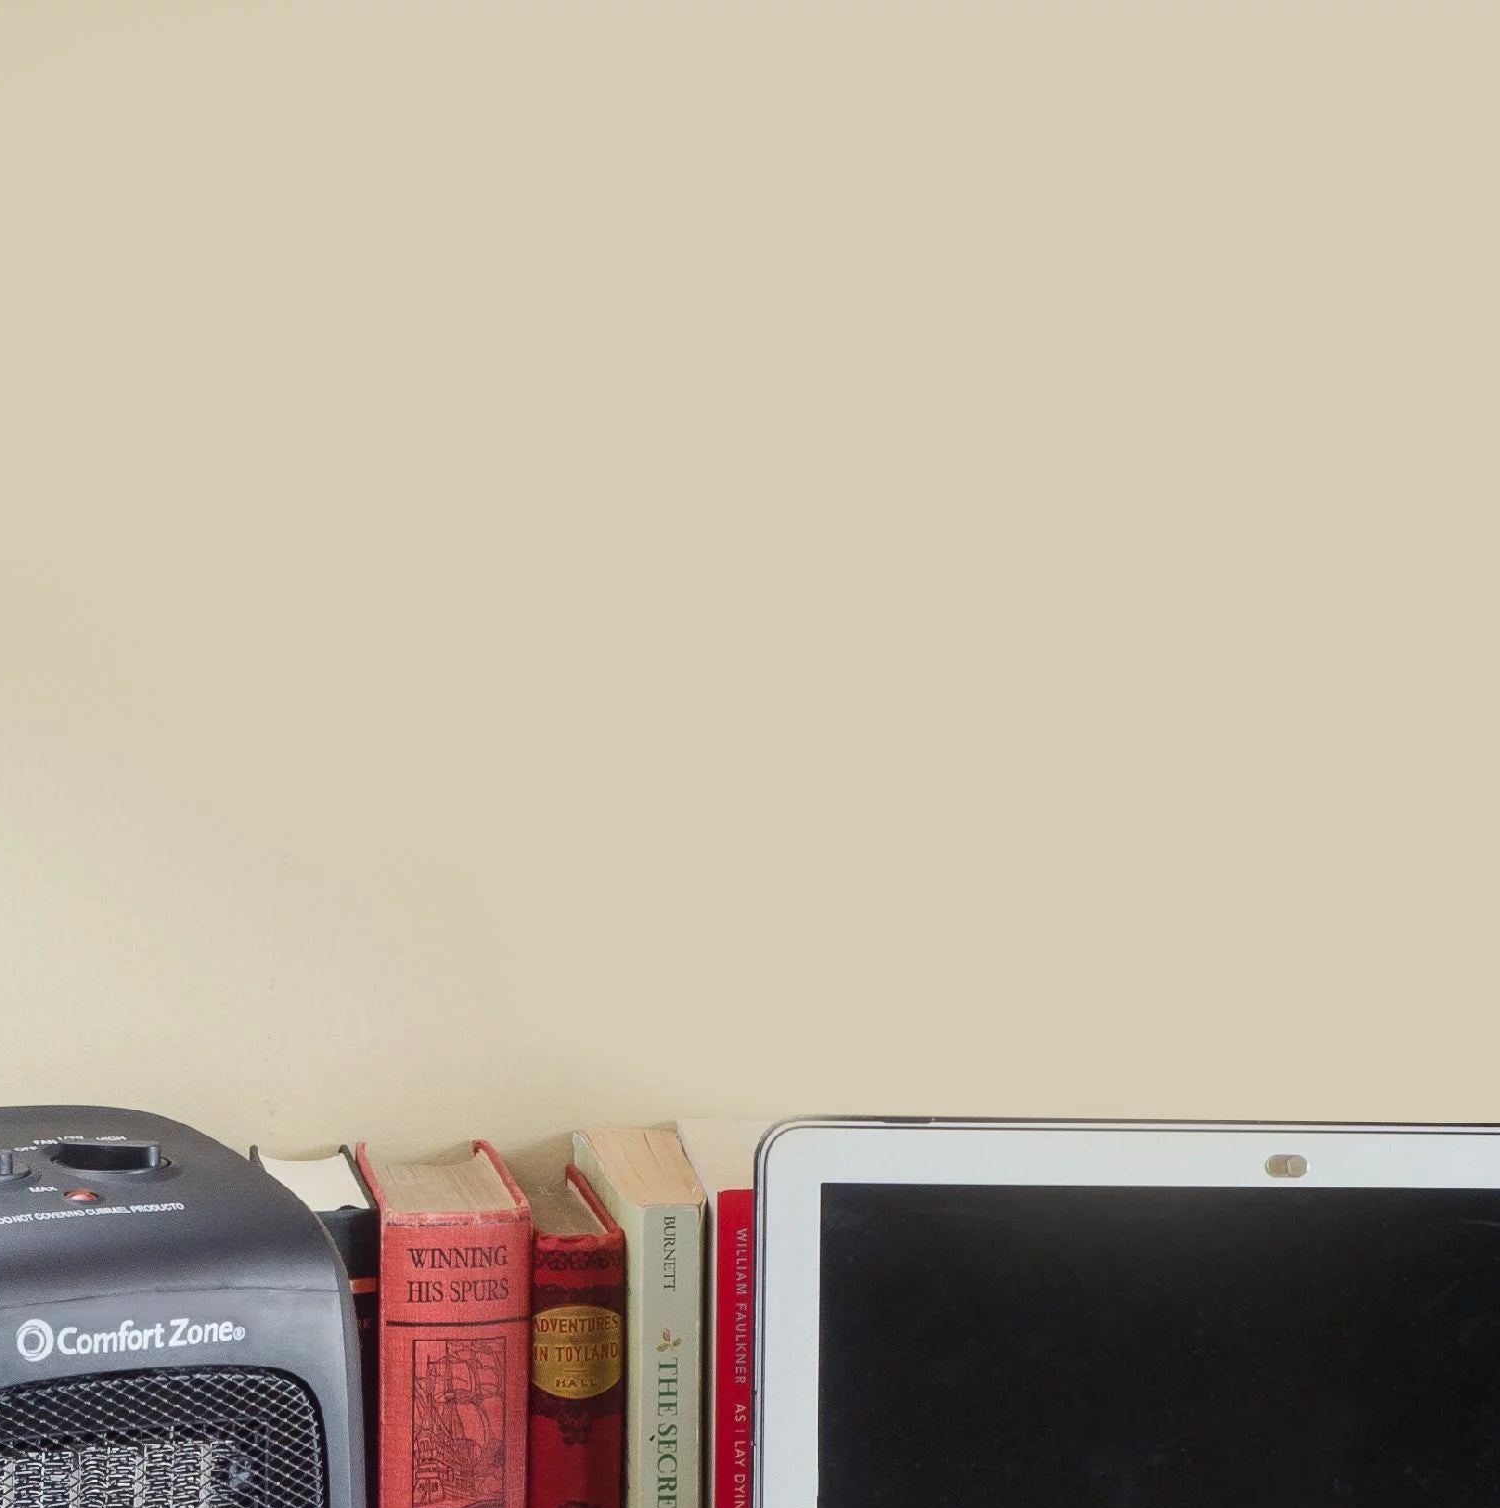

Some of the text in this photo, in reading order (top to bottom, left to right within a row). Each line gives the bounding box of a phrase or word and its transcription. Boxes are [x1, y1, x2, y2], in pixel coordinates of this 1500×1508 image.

[13, 1212, 34, 1223] NOT
[130, 1202, 185, 1214] PRODUCTO
[407, 1246, 509, 1270] WINNING
[663, 1216, 676, 1292] BURNETT
[736, 1228, 748, 1296] WILLIAM
[407, 1277, 509, 1303] HIS SPURS
[57, 1319, 165, 1355] Comfort
[533, 1315, 619, 1333] ADVENTURES
[534, 1343, 619, 1362] IN TOYLAND
[735, 1303, 747, 1384] FAULKNER
[555, 1378, 597, 1388] HALL
[658, 1358, 678, 1416] THE
[734, 1404, 746, 1422] AS
[734, 1442, 746, 1468] LAY
